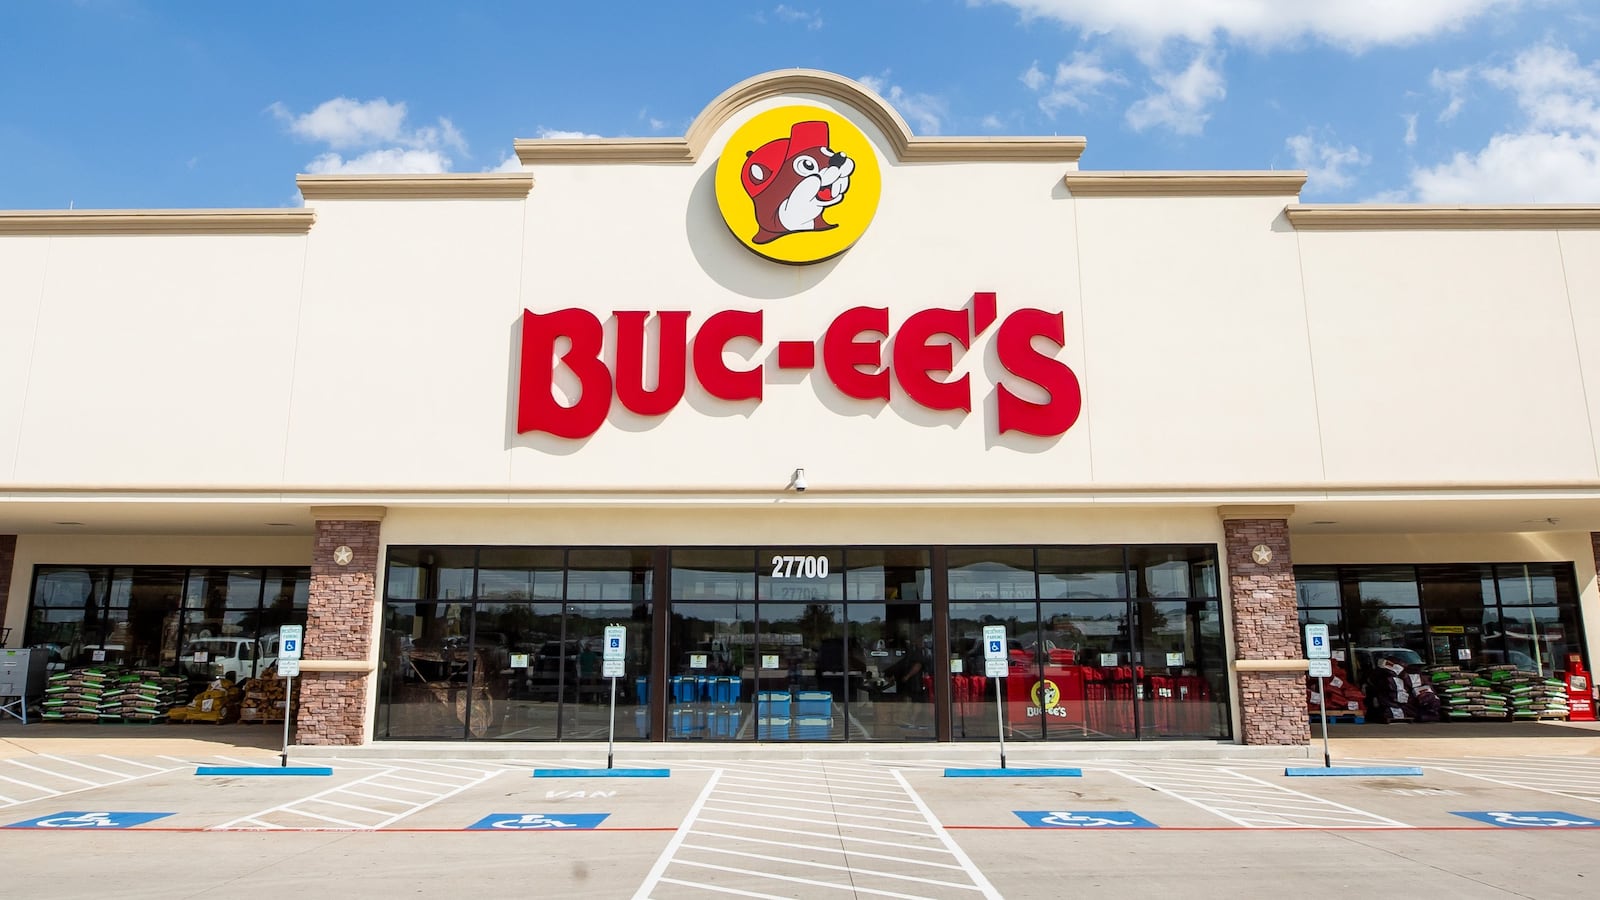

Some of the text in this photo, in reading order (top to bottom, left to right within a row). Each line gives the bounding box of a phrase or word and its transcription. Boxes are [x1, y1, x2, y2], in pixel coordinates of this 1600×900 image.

[517, 292, 1081, 440] BUC-EE'S
[772, 555, 829, 578] 27700
[545, 790, 617, 800] VAN
